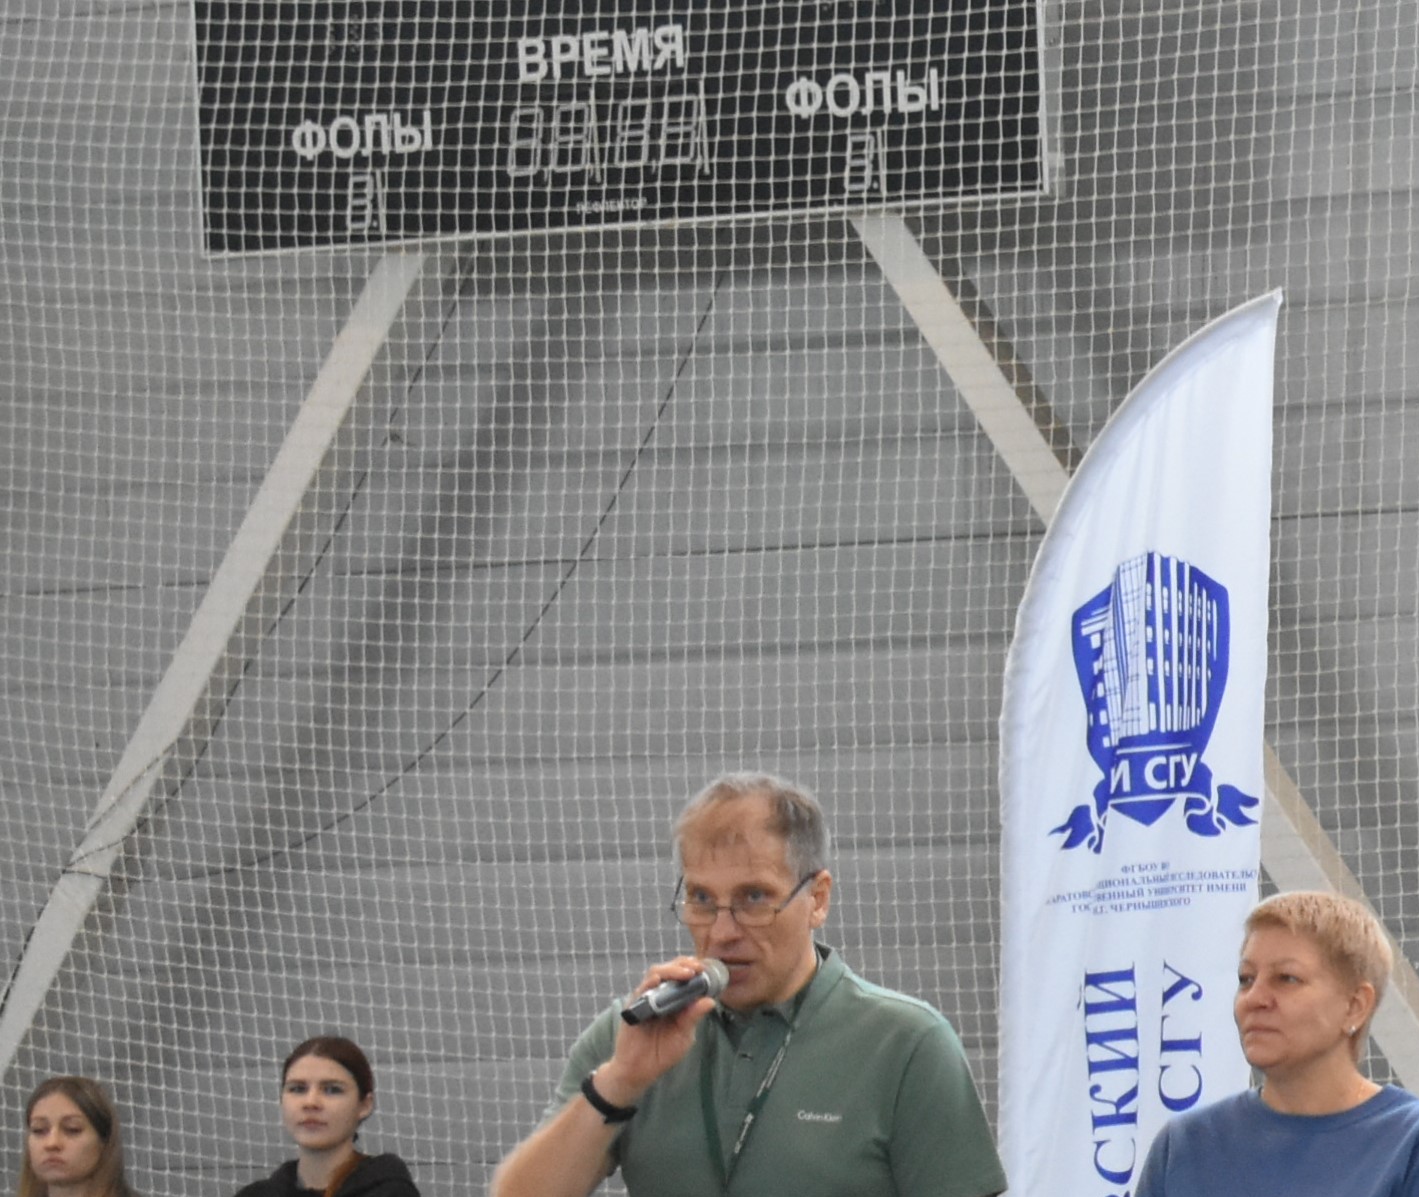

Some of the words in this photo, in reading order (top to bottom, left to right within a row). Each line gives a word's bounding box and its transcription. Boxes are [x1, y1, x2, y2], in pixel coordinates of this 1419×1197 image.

[517, 24, 685, 82] ВРЕМЯ
[785, 67, 939, 119] ФОЛЫ
[292, 110, 432, 161] ФОЛЫ
[1144, 753, 1198, 790] СГУ
[1158, 960, 1202, 1112] СГУ
